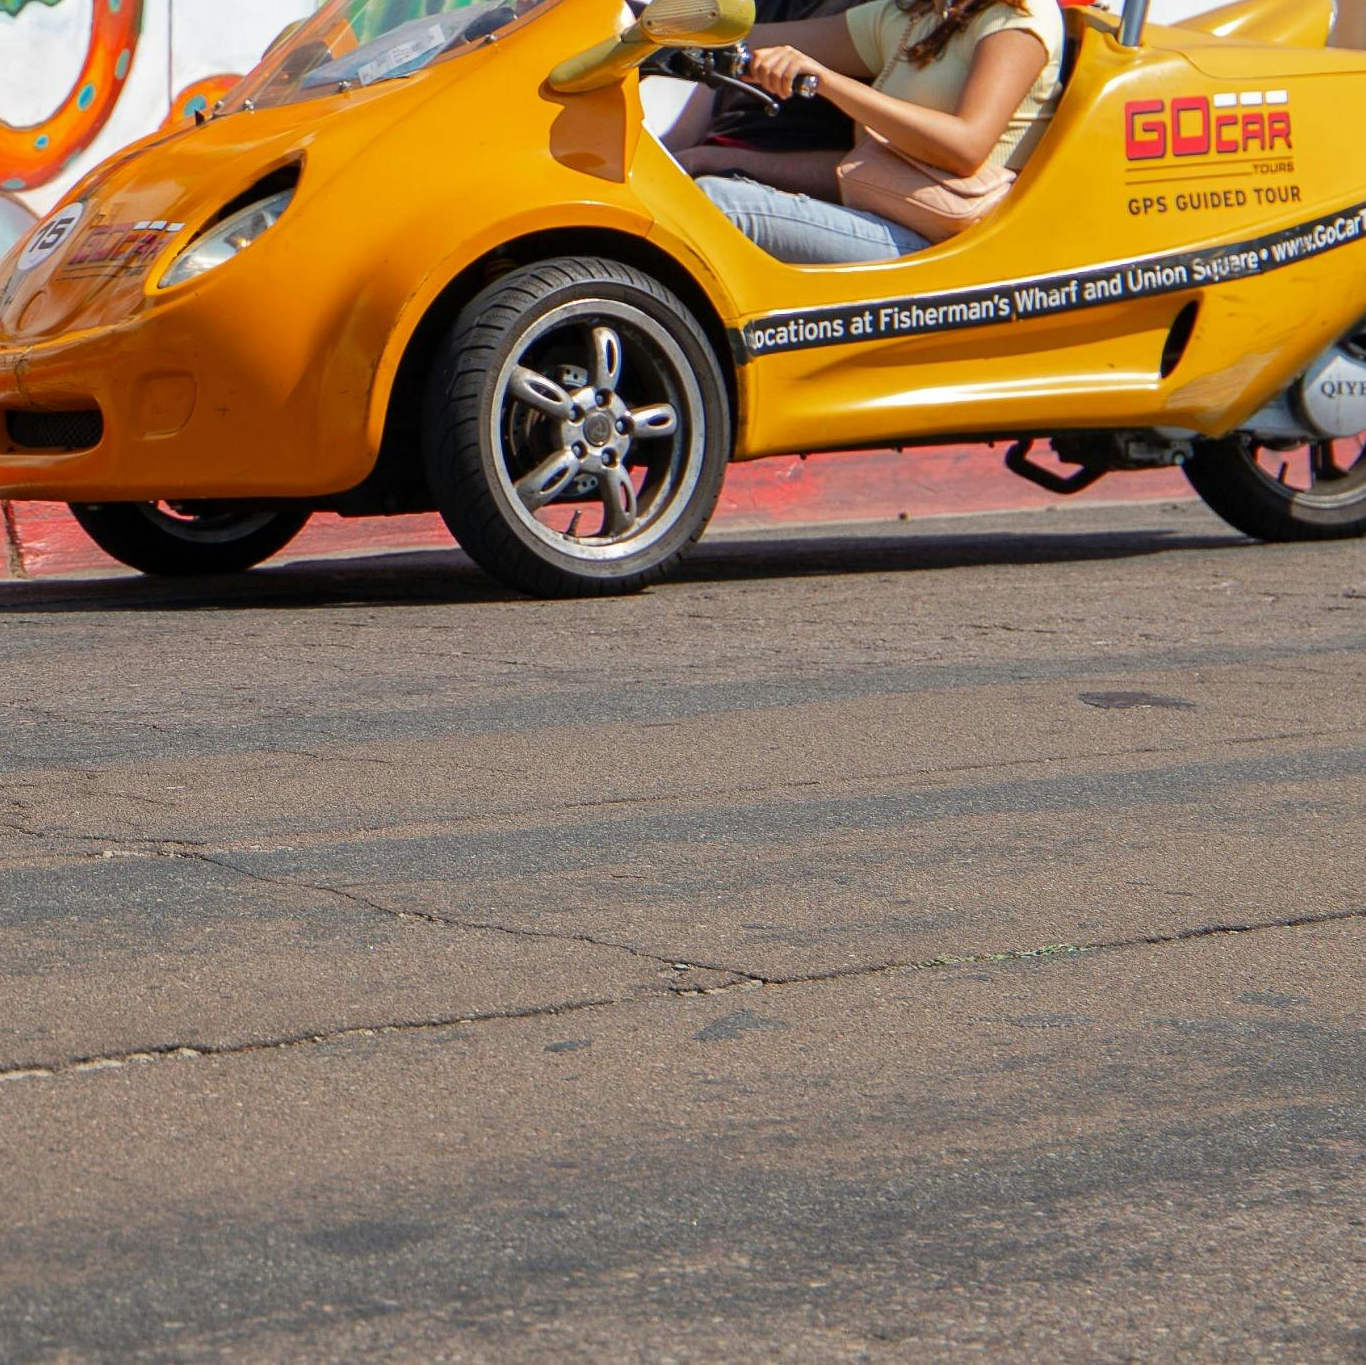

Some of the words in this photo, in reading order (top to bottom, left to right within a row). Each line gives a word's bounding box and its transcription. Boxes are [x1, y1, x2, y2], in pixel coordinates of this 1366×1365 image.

[1252, 161, 1295, 175] TOURS
[1128, 196, 1168, 216] GPS
[1176, 190, 1247, 212] GUIDED
[1255, 185, 1302, 205] TOUR
[28, 217, 75, 253] 15
[850, 312, 873, 335] at
[879, 296, 1011, 332] Fisherman's
[1014, 280, 1078, 314] Wharf
[1084, 272, 1122, 301] and
[1127, 261, 1187, 292] Union
[1192, 250, 1259, 282] Square
